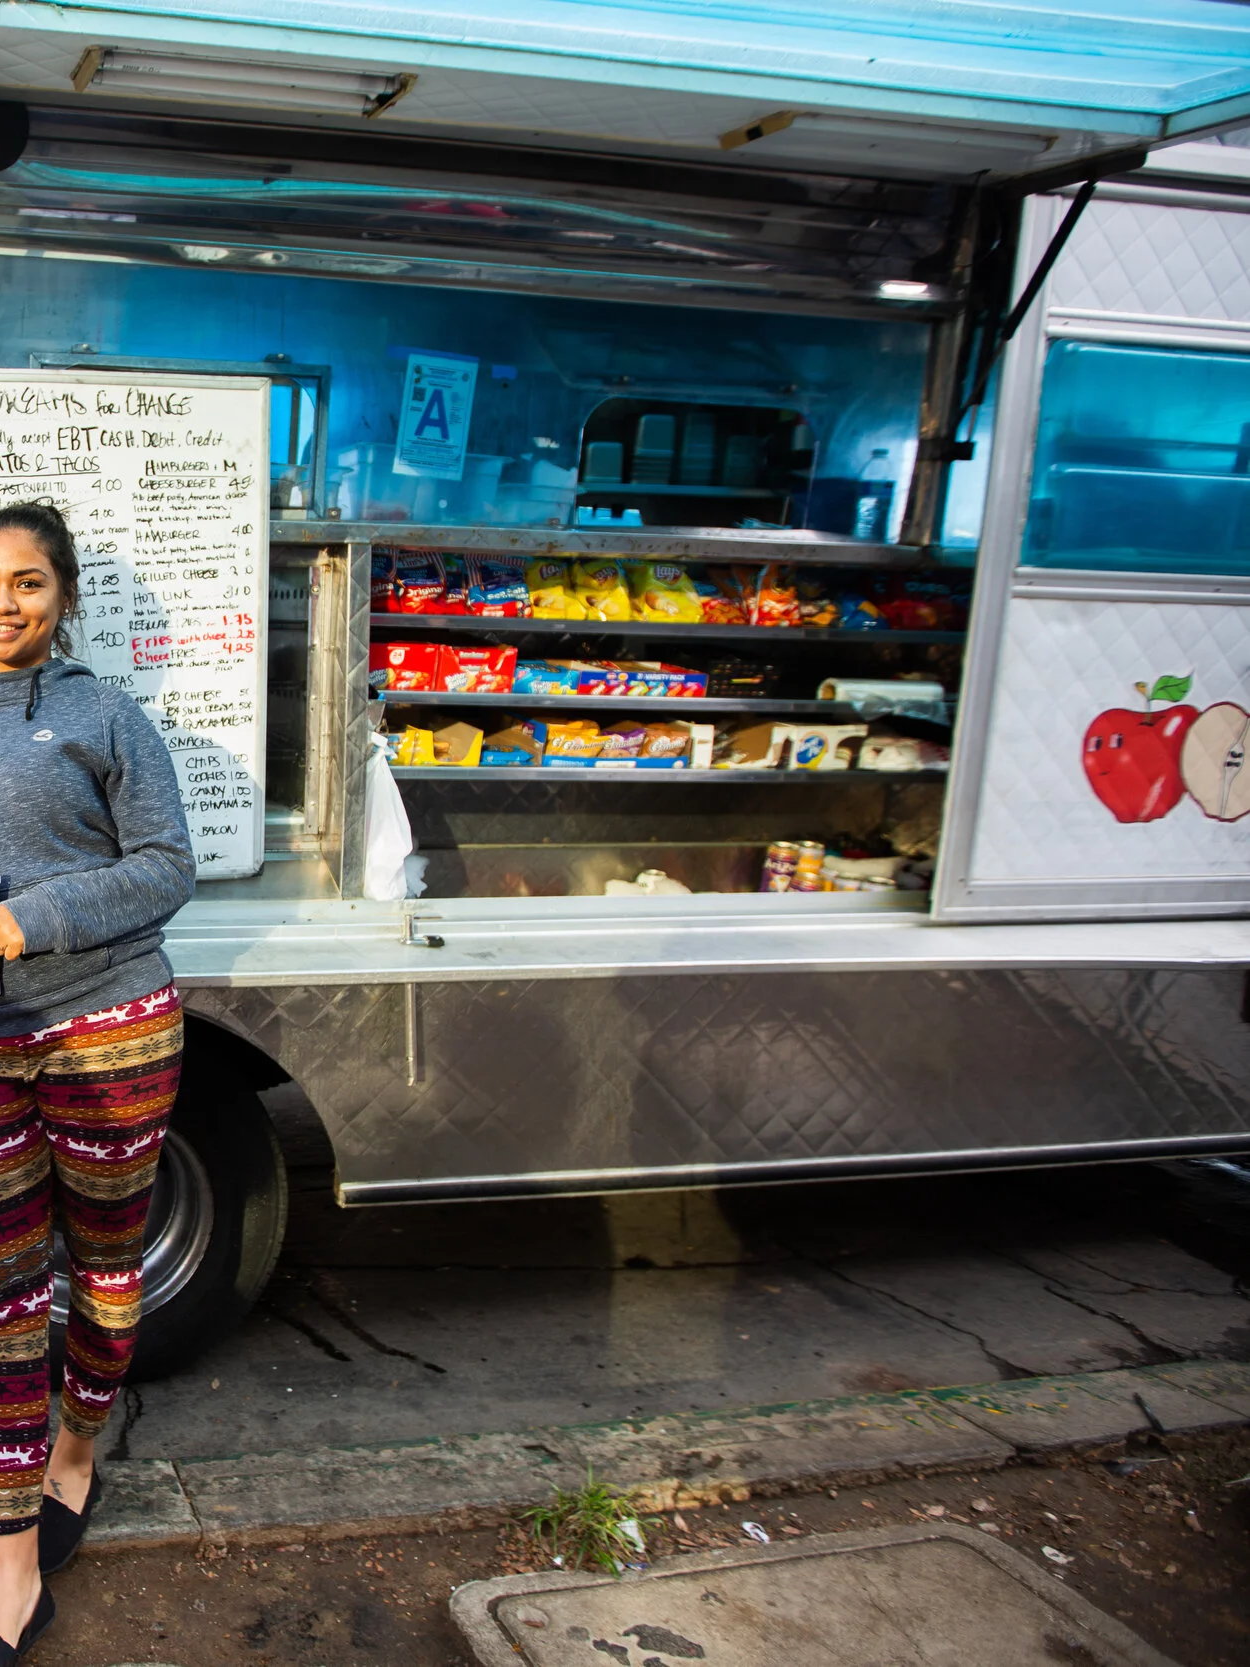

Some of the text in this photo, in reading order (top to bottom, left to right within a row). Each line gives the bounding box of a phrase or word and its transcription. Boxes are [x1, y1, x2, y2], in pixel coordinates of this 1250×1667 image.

[126, 387, 193, 418] CHANGE
[414, 388, 450, 440] A
[186, 428, 224, 447] Credit
[50, 455, 100, 476] TACOS
[135, 529, 200, 544] HAMBURGER
[133, 571, 177, 586] GRILLED
[133, 592, 156, 606] HOT
[162, 588, 193, 602] LINK
[131, 634, 173, 651] Fries
[168, 737, 214, 748] SNACKS
[185, 755, 220, 769] CHIPS
[197, 824, 238, 838] BACON
